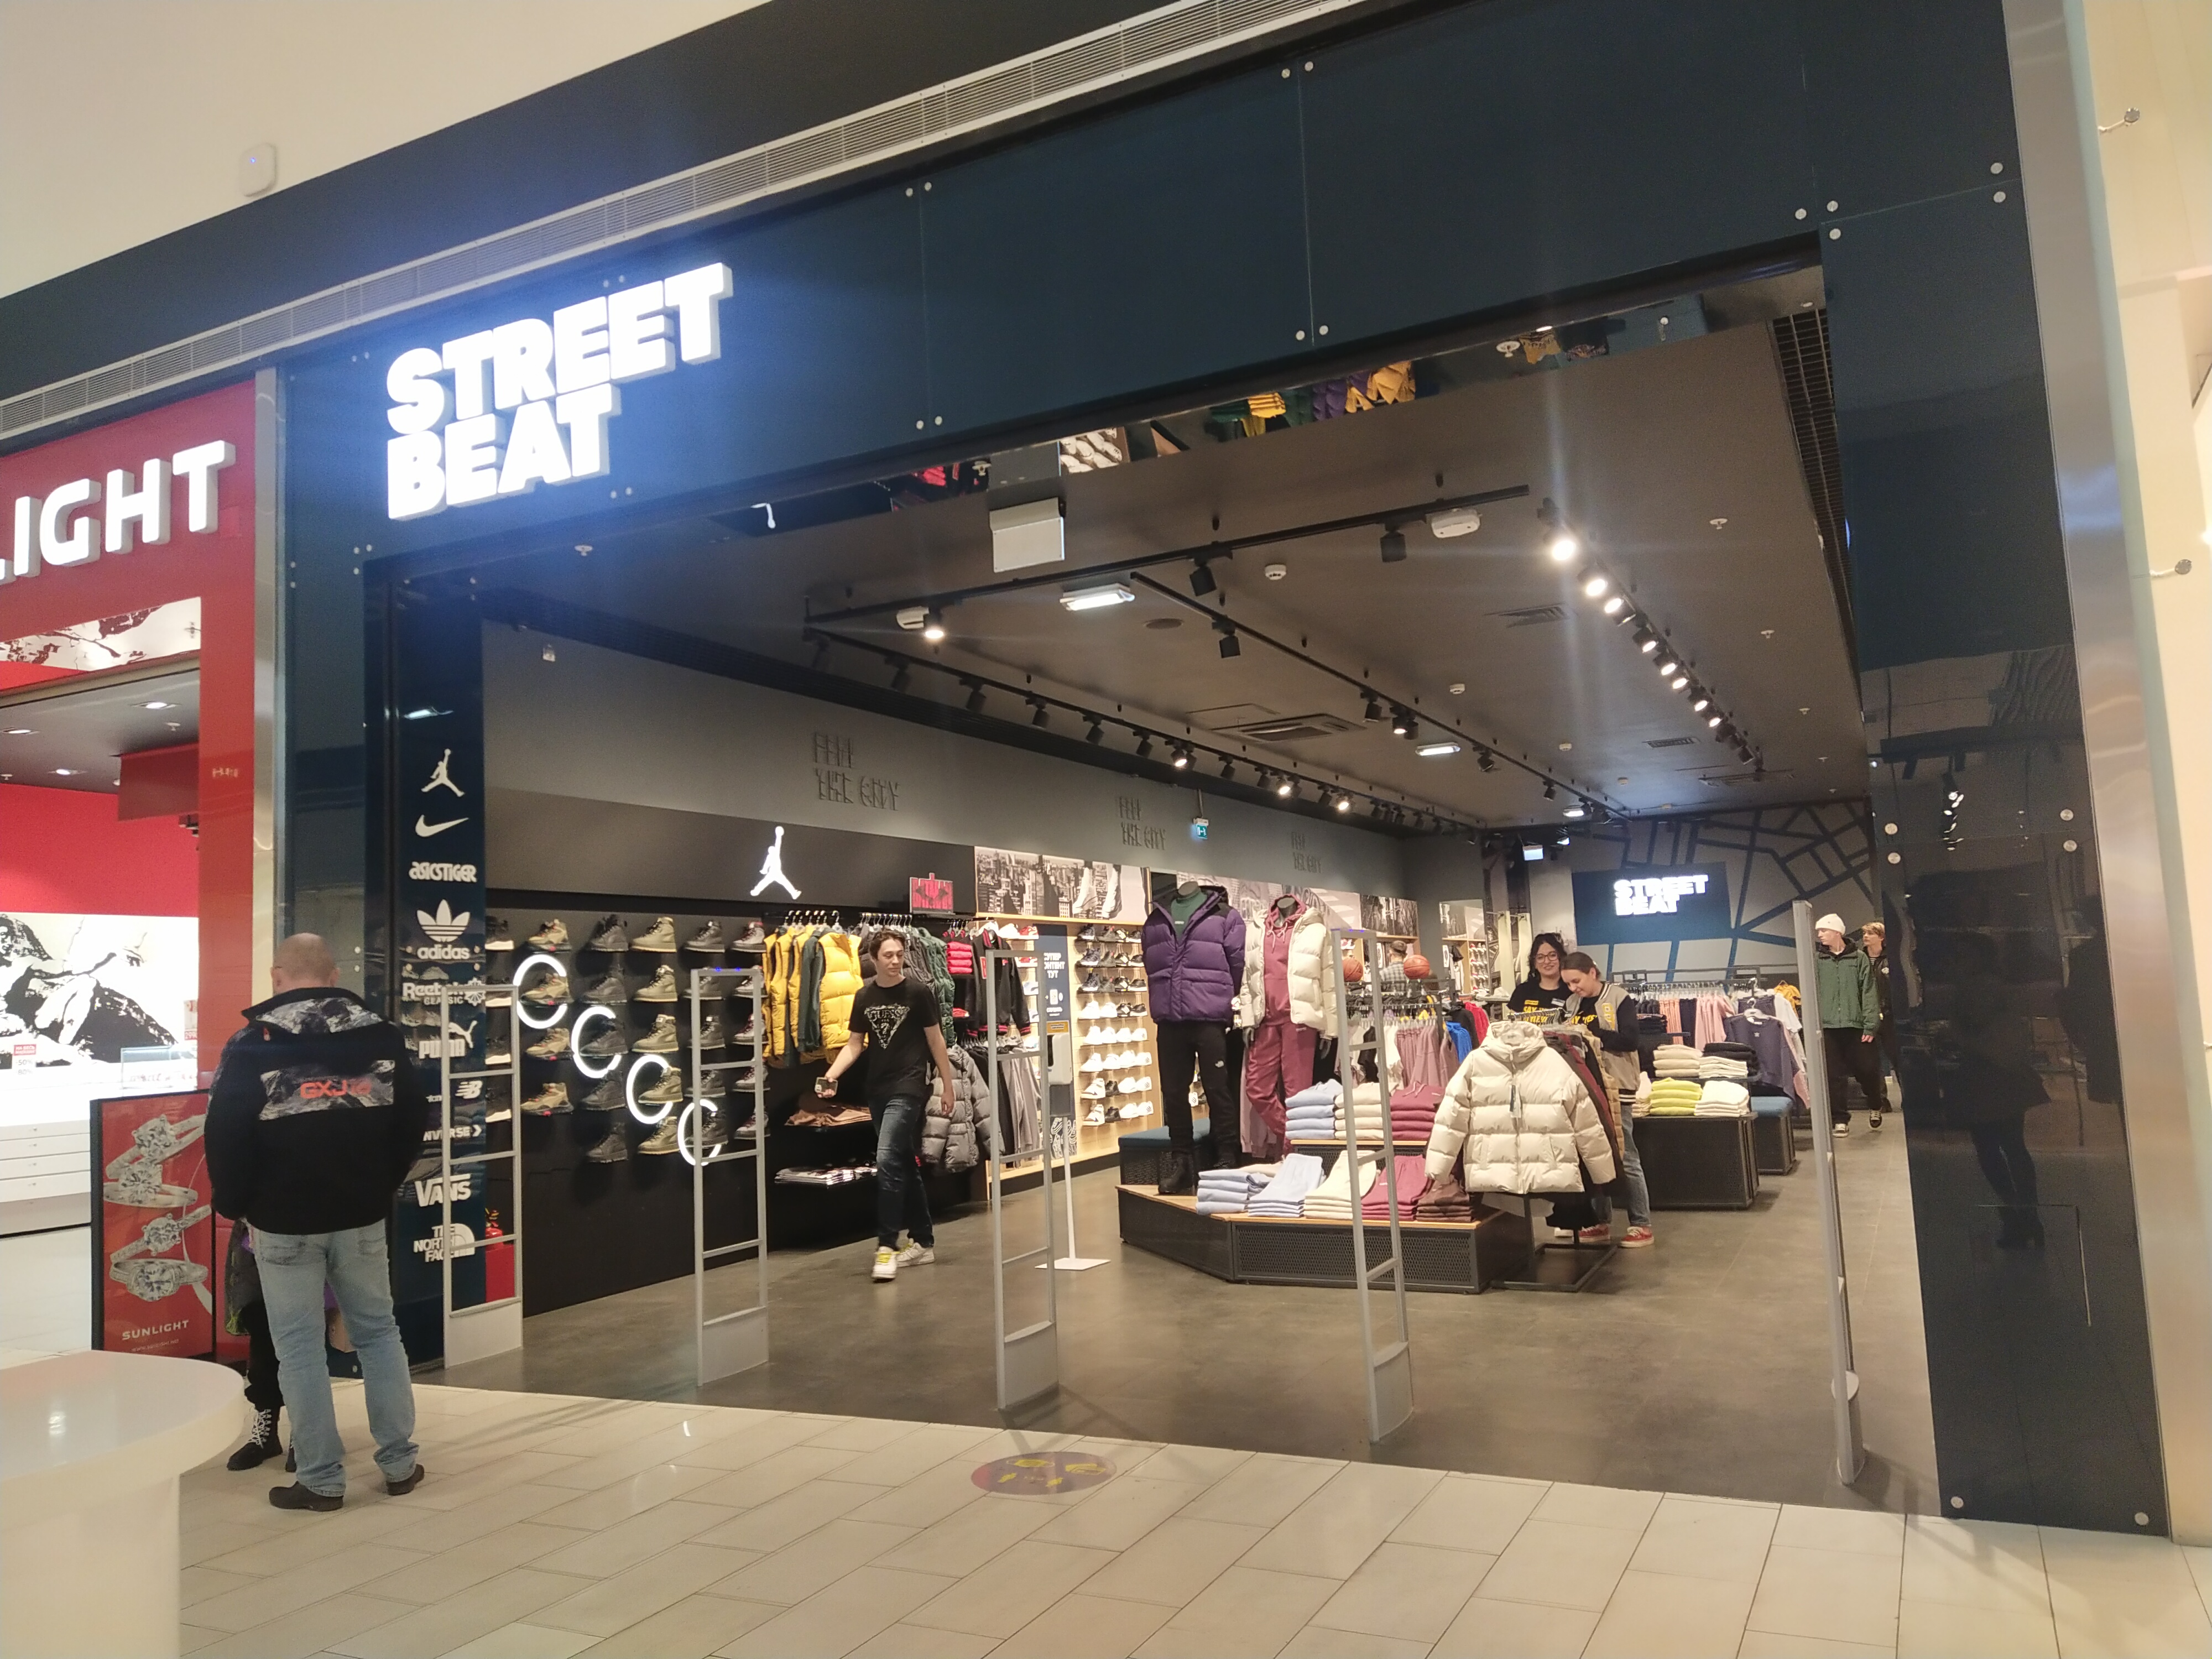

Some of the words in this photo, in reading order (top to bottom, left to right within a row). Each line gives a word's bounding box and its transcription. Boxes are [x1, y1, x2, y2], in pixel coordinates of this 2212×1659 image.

[387, 262, 733, 435] STREET
[387, 382, 620, 520] BEAT
[0, 440, 234, 584] IGHT
[1614, 874, 1709, 899] STREET
[1615, 894, 1679, 916] BEAT
[417, 945, 470, 960] adidas
[424, 996, 464, 1005] CLASIC
[415, 1173, 471, 1207] VANS
[122, 1320, 189, 1341] SUNLIGHT
